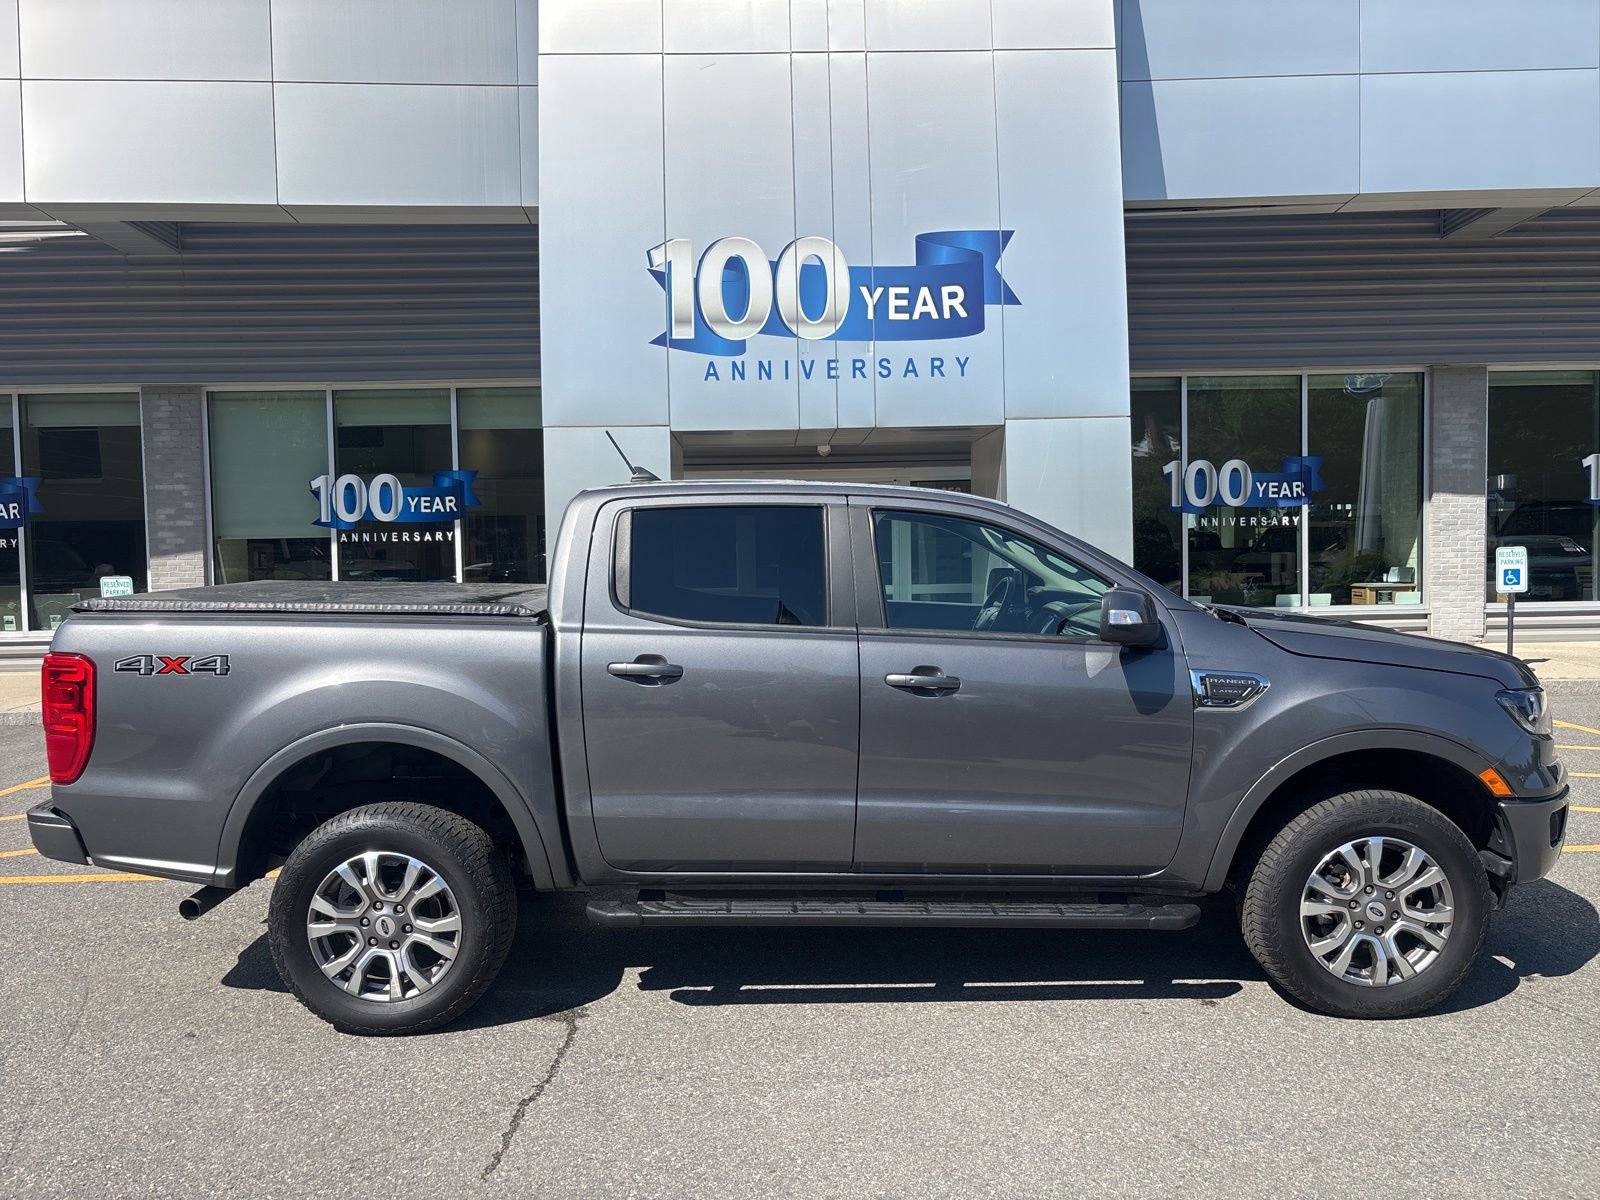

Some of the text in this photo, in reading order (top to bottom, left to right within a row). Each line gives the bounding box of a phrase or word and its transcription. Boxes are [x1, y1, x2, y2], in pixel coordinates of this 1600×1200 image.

[646, 235, 968, 341] 100 YEAR
[704, 356, 970, 382] ANNIVERSARY
[310, 473, 458, 522] 100 YEAR
[1162, 458, 1306, 508] 100 YEAR
[339, 531, 454, 543] ANNIVERSARY
[114, 654, 231, 677] 4X4
